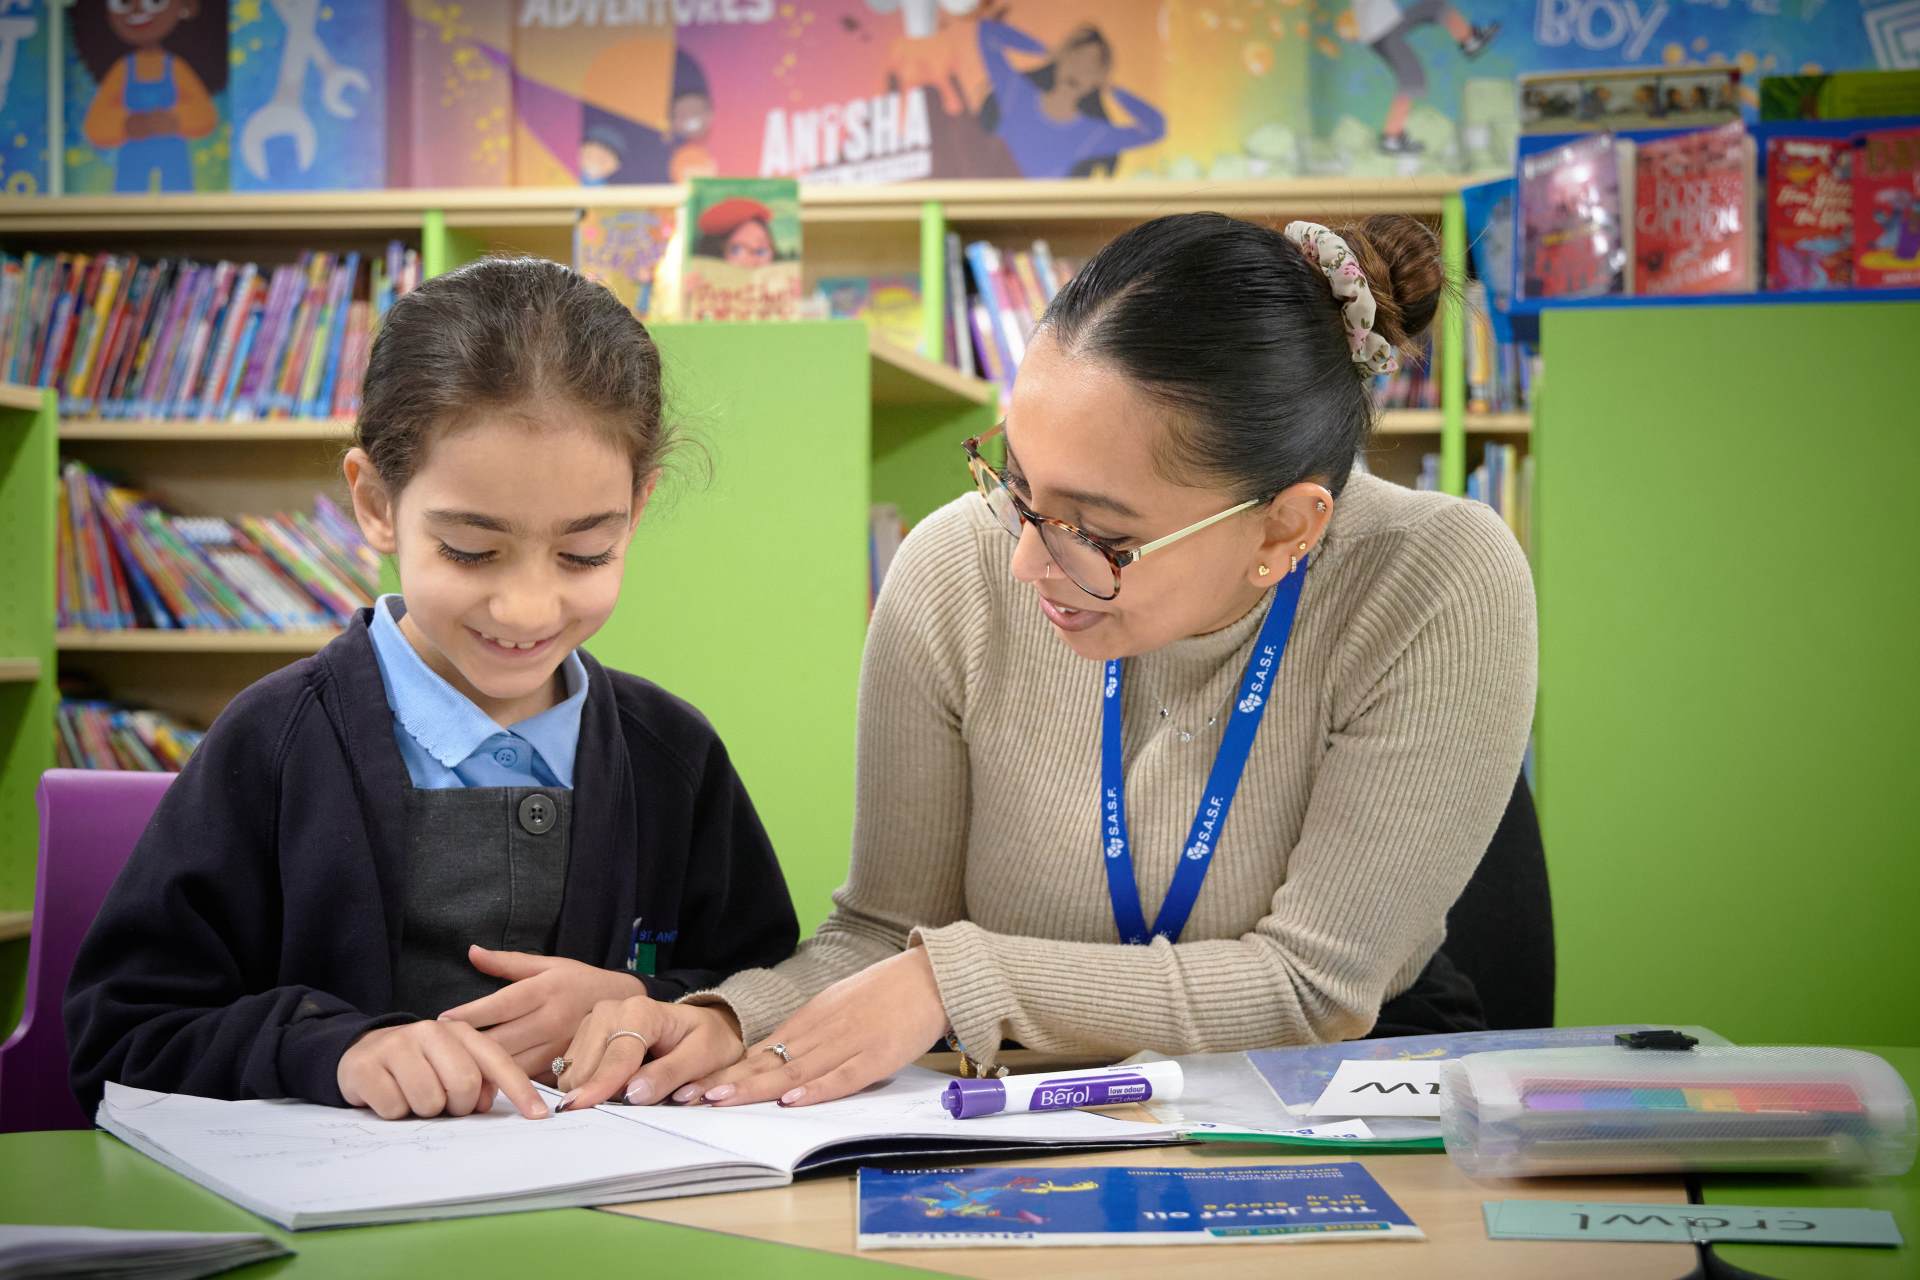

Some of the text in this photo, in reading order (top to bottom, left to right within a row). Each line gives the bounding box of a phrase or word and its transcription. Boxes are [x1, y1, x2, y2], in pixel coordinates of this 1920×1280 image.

[1534, 0, 1670, 62] BOY
[759, 86, 932, 178] ANISHA
[1251, 644, 1278, 692] S.A.S.F.
[1107, 787, 1119, 836] S.A.S.F.
[1199, 796, 1224, 841] S.A.S.F.
[1109, 1086, 1145, 1095] low odour
[1143, 1211, 1191, 1221] oil
[1200, 1210, 1237, 1219] of
[1309, 1206, 1377, 1215] The
[1570, 1213, 1816, 1233] crawl
